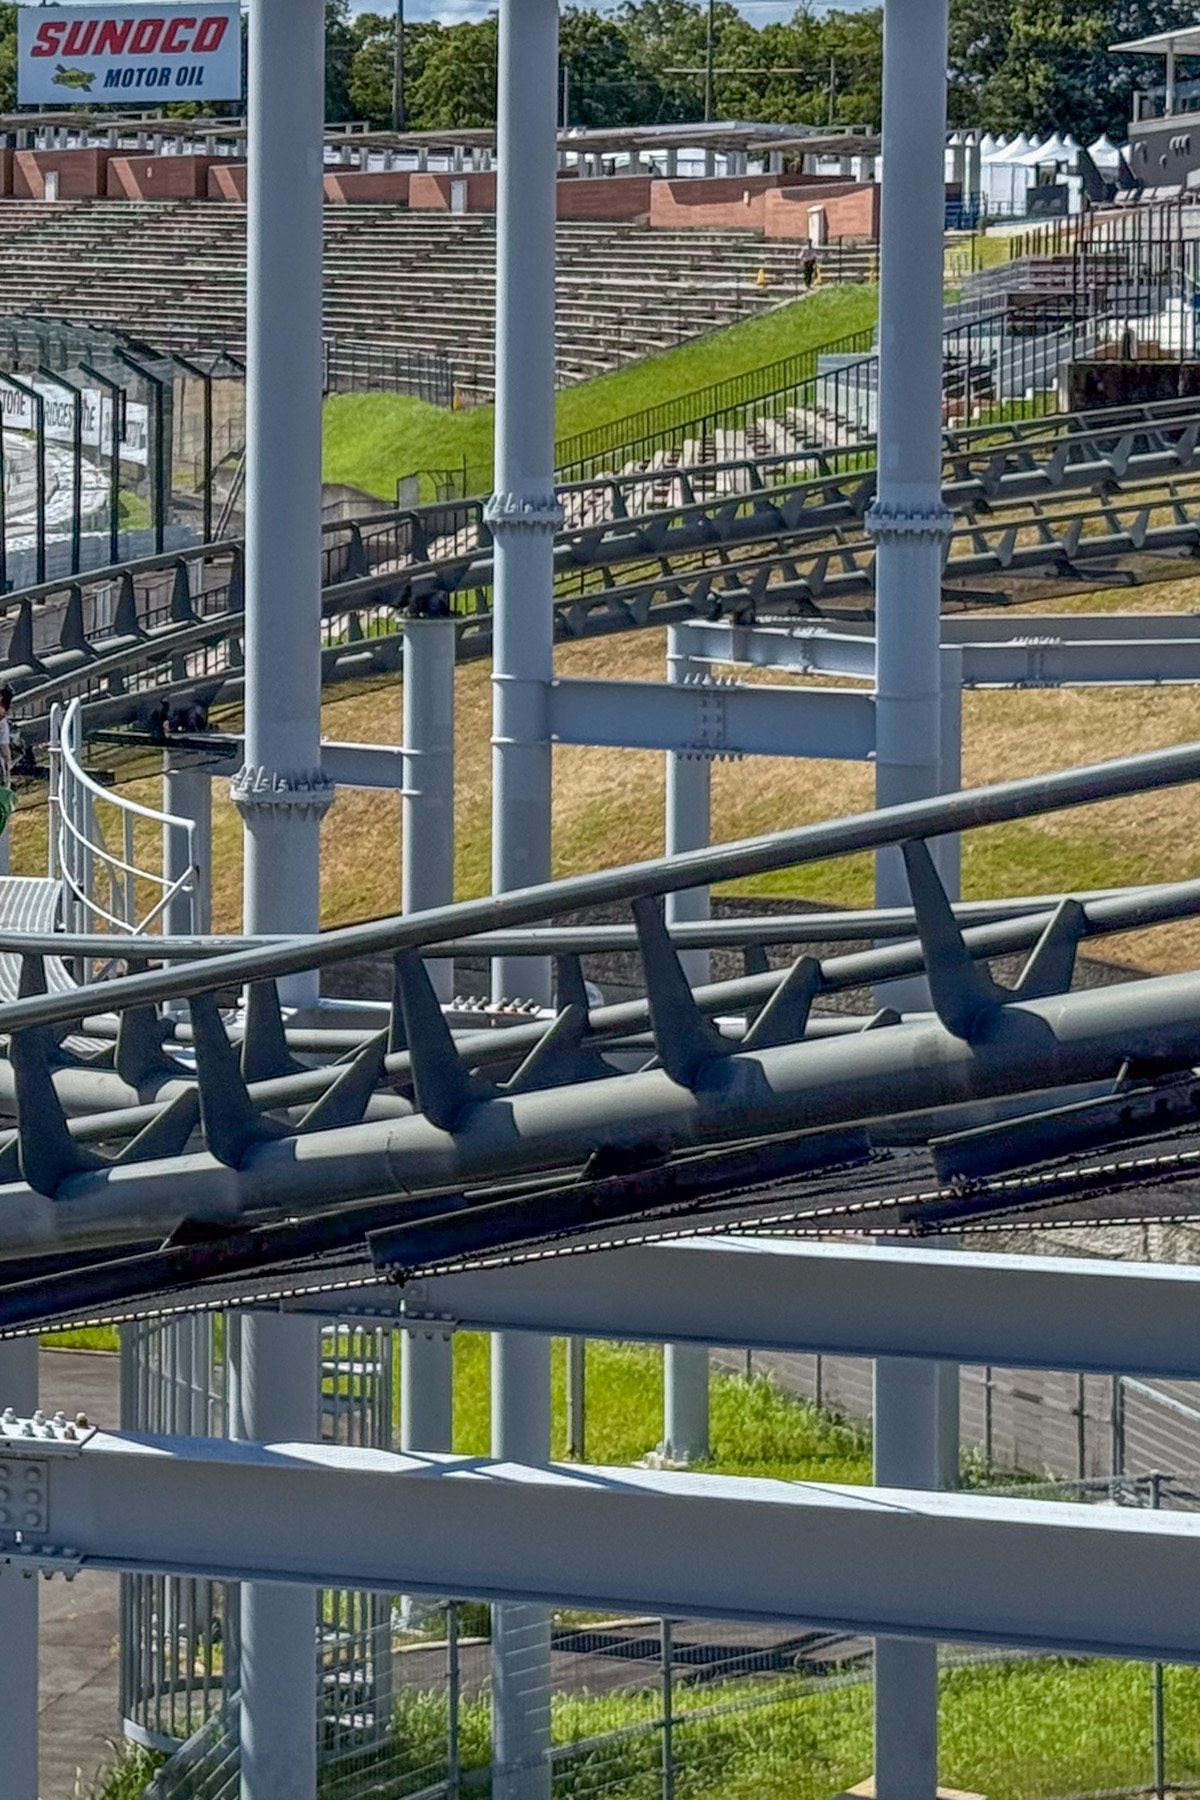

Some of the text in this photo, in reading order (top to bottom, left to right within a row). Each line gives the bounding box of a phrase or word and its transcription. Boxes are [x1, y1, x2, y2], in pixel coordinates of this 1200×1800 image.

[30, 16, 230, 58] SUNOCO
[103, 67, 171, 88] MOTOR
[175, 66, 205, 86] OIL
